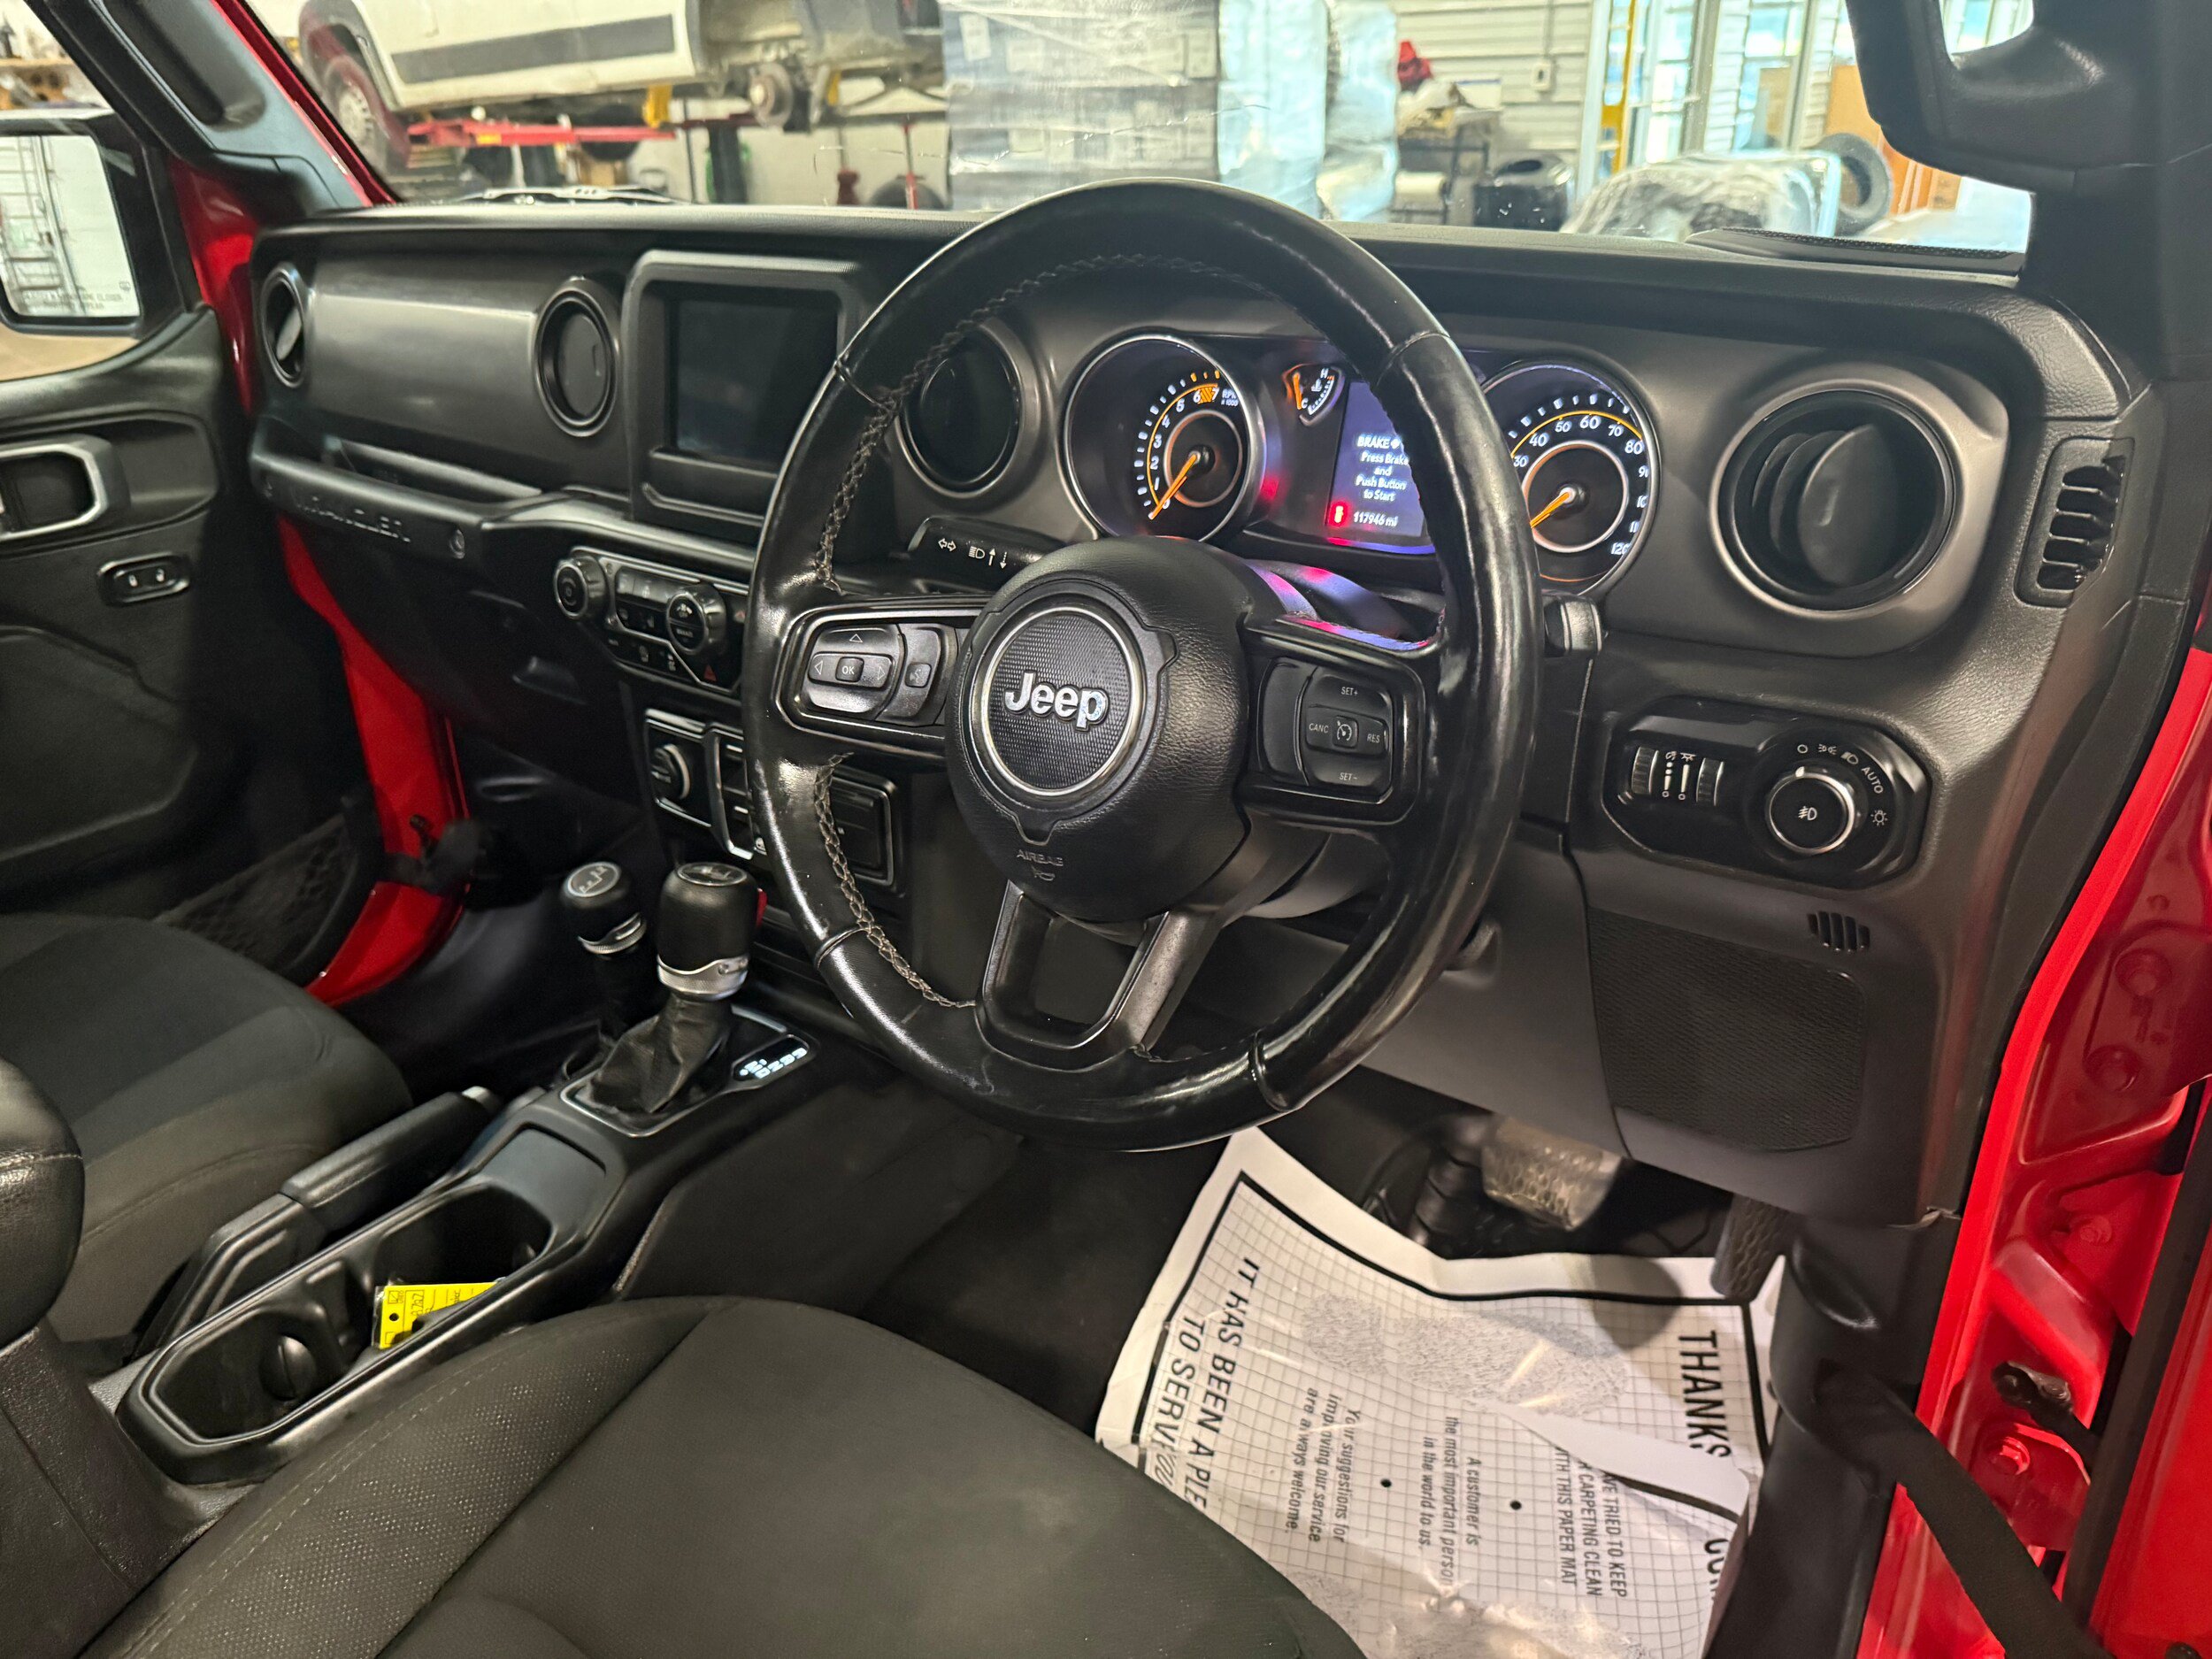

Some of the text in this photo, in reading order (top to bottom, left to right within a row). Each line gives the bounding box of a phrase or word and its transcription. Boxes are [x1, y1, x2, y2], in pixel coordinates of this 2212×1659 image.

[1320, 368, 1329, 379] H
[1193, 389, 1201, 403] 6
[1211, 387, 1220, 401] 7
[1176, 398, 1185, 412] 5
[1302, 398, 1310, 409] C
[1162, 414, 1171, 428] 4
[1555, 420, 1572, 433] 50
[1579, 416, 1601, 429] 60
[1608, 424, 1624, 437] 70
[1153, 434, 1162, 449] 3
[1357, 435, 1391, 449] BRAKE
[1529, 433, 1549, 447] 40
[1624, 440, 1645, 455] 80
[1150, 456, 1159, 470] 2
[1361, 451, 1409, 465] Press Brake
[1513, 455, 1529, 467] 30
[1374, 465, 1393, 476] and
[1154, 477, 1160, 491] 1
[1356, 475, 1407, 490] Push Button
[1363, 489, 1395, 502] to Start
[1354, 512, 1385, 526] 117946
[1629, 521, 1640, 533] 11
[841, 665, 856, 675] OK
[1004, 671, 1108, 729] Jeep
[1309, 723, 1329, 733] CANC
[1367, 733, 1380, 743] RES
[1861, 766, 1885, 795] AUTO
[1017, 849, 1064, 866] AIRBAG
[1238, 1257, 1260, 1288] IT
[1217, 1289, 1249, 1348] HAS
[1178, 1315, 1205, 1353] TO
[1196, 1353, 1236, 1434] BEEN
[1303, 1386, 1318, 1414] are
[1446, 1416, 1459, 1434] the
[1187, 1438, 1215, 1457] A
[1291, 1417, 1311, 1467] aways
[1424, 1436, 1438, 1448] in
[1444, 1437, 1458, 1468] most
[1421, 1451, 1438, 1472] the
[1315, 1468, 1327, 1490] our
[1335, 1443, 1354, 1520] suggestions
[1420, 1474, 1436, 1509] world
[1555, 1475, 1572, 1508] THIS
[1442, 1471, 1459, 1535] important
[1466, 1456, 1482, 1547] A customer is
[1578, 1473, 1599, 1547] CARPETING
[1308, 1492, 1325, 1543] service
[1419, 1511, 1434, 1526] to
[1602, 1498, 1621, 1536] TRIED
[1333, 1523, 1349, 1543] for
[1558, 1509, 1576, 1552] PAPER
[1607, 1540, 1624, 1557] TO
[1560, 1557, 1578, 1586] MAT
[1584, 1551, 1602, 1596] CLEAN
[1609, 1562, 1627, 1598] KEEP
